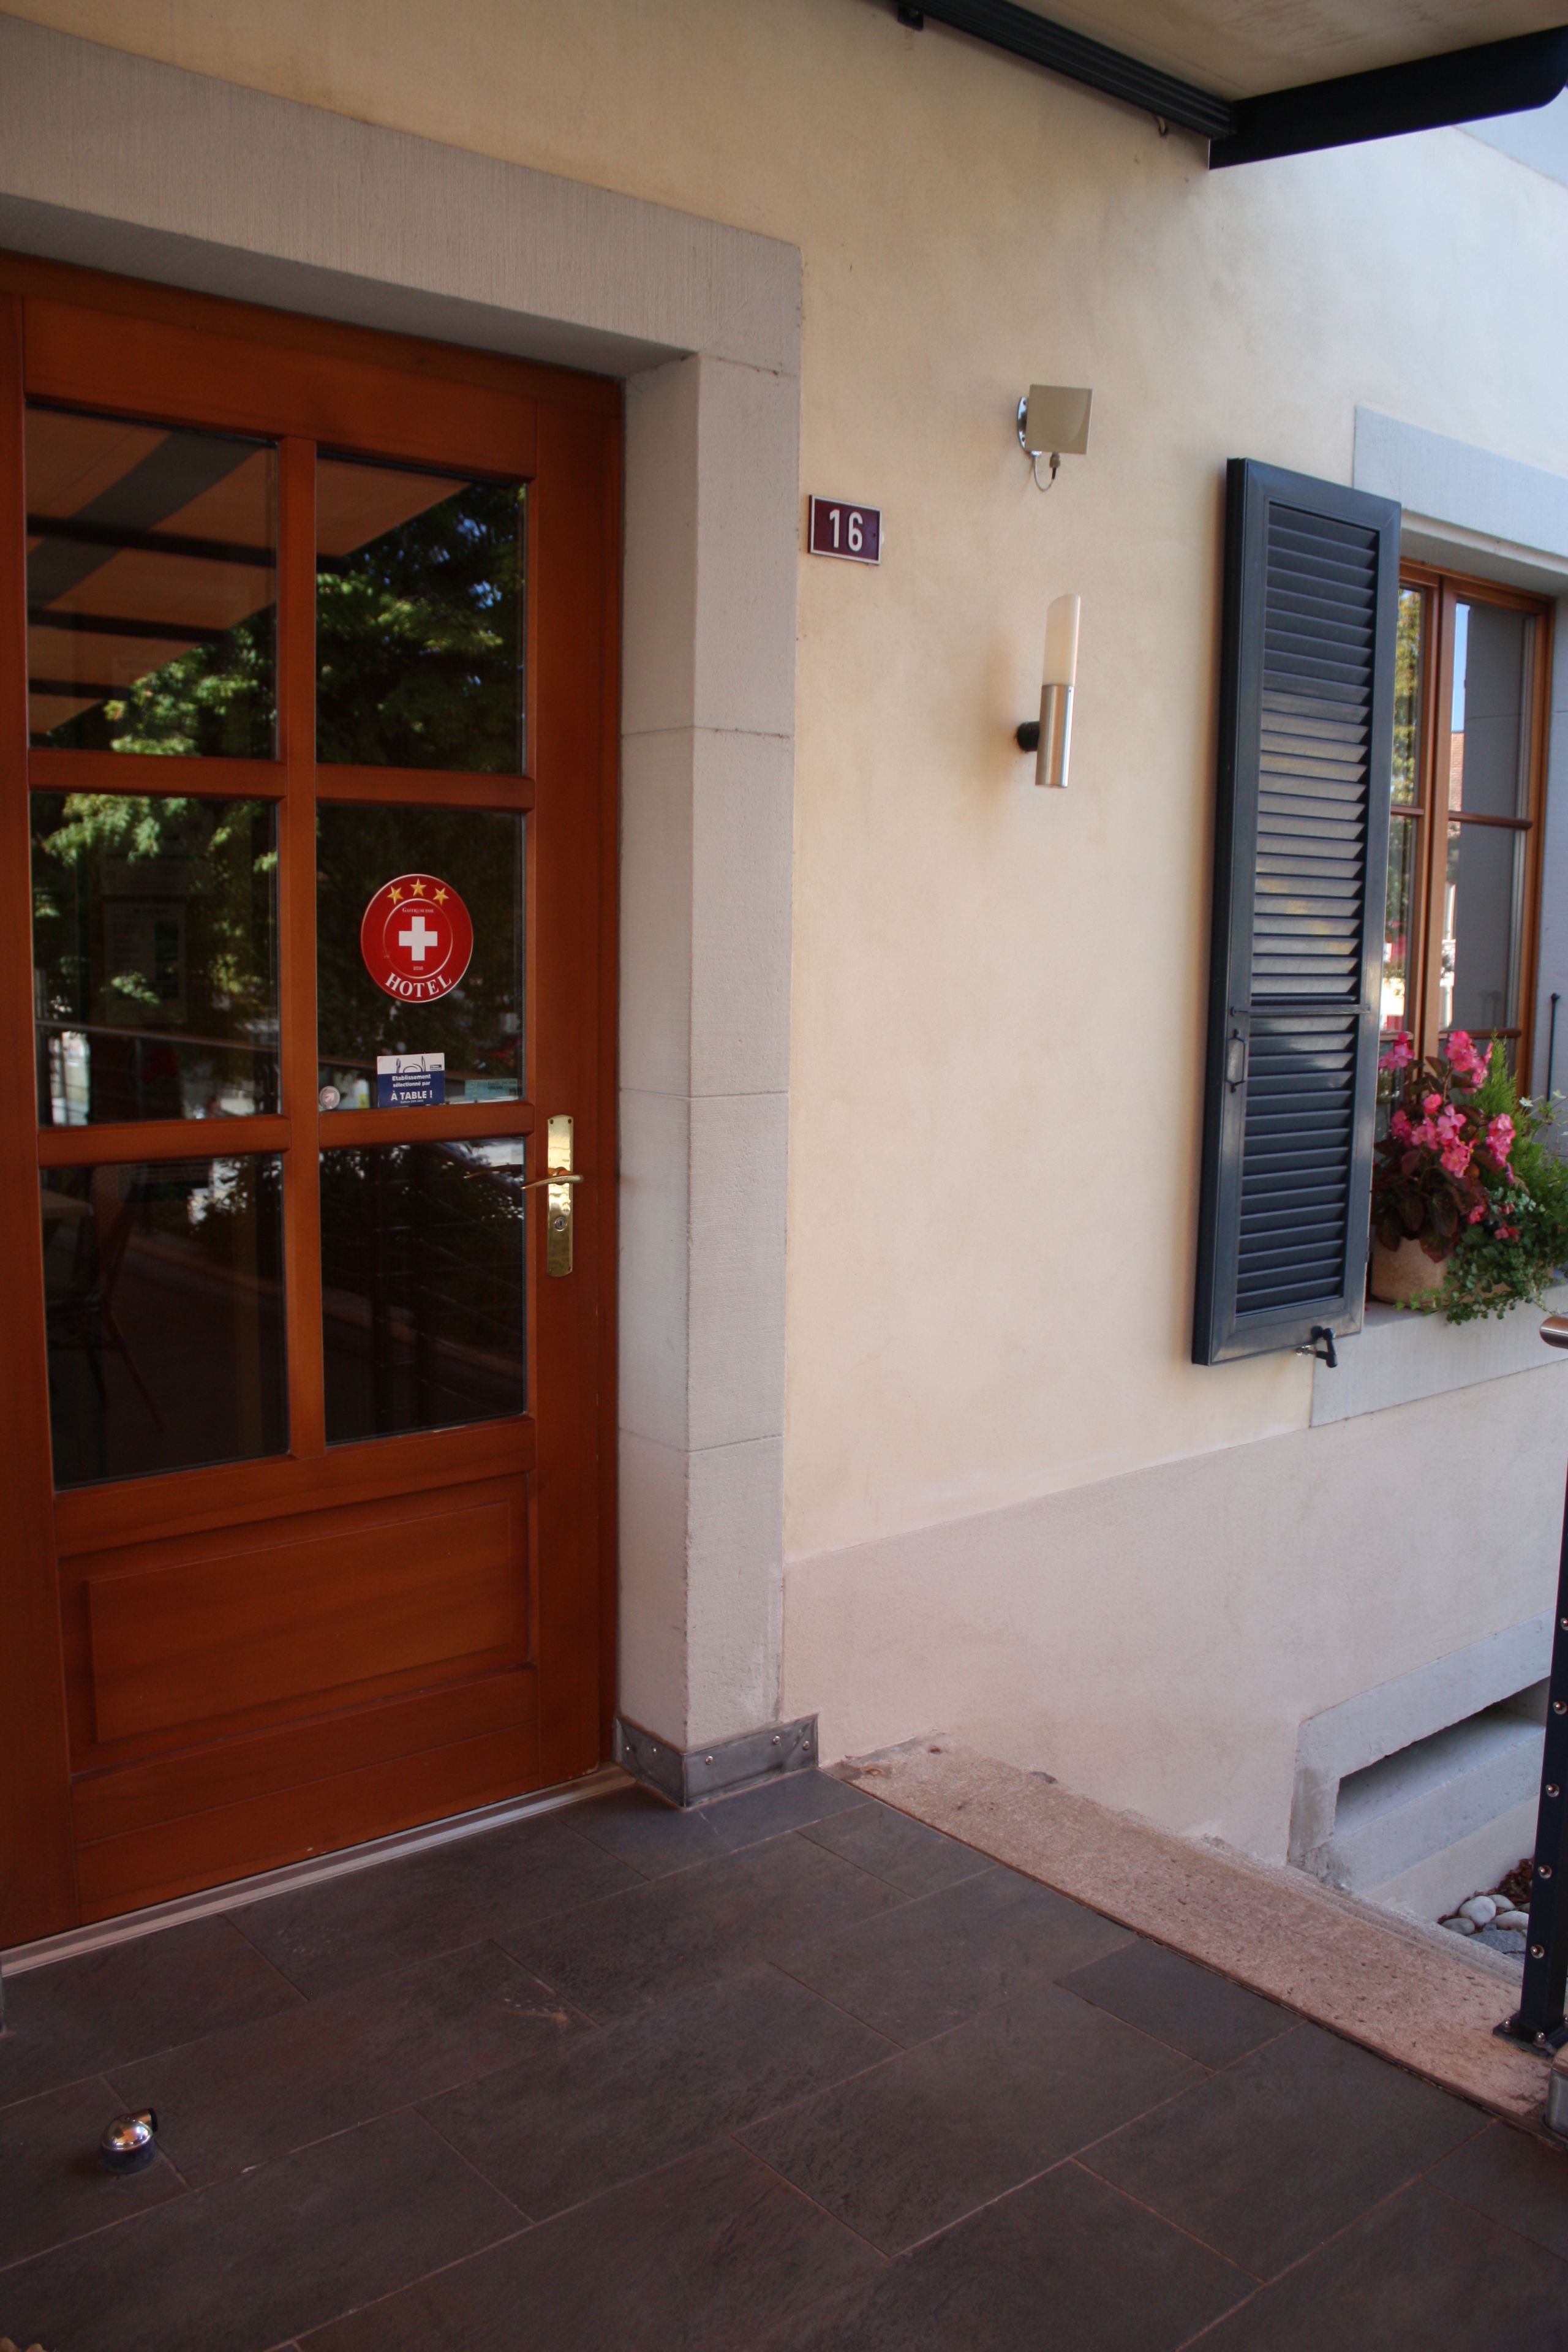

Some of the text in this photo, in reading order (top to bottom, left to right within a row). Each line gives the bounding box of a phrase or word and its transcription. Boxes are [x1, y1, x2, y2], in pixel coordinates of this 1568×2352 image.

[829, 509, 863, 552] 16
[385, 972, 452, 998] HOTEL
[391, 1090, 398, 1101] À
[400, 1091, 427, 1099] TABLE
